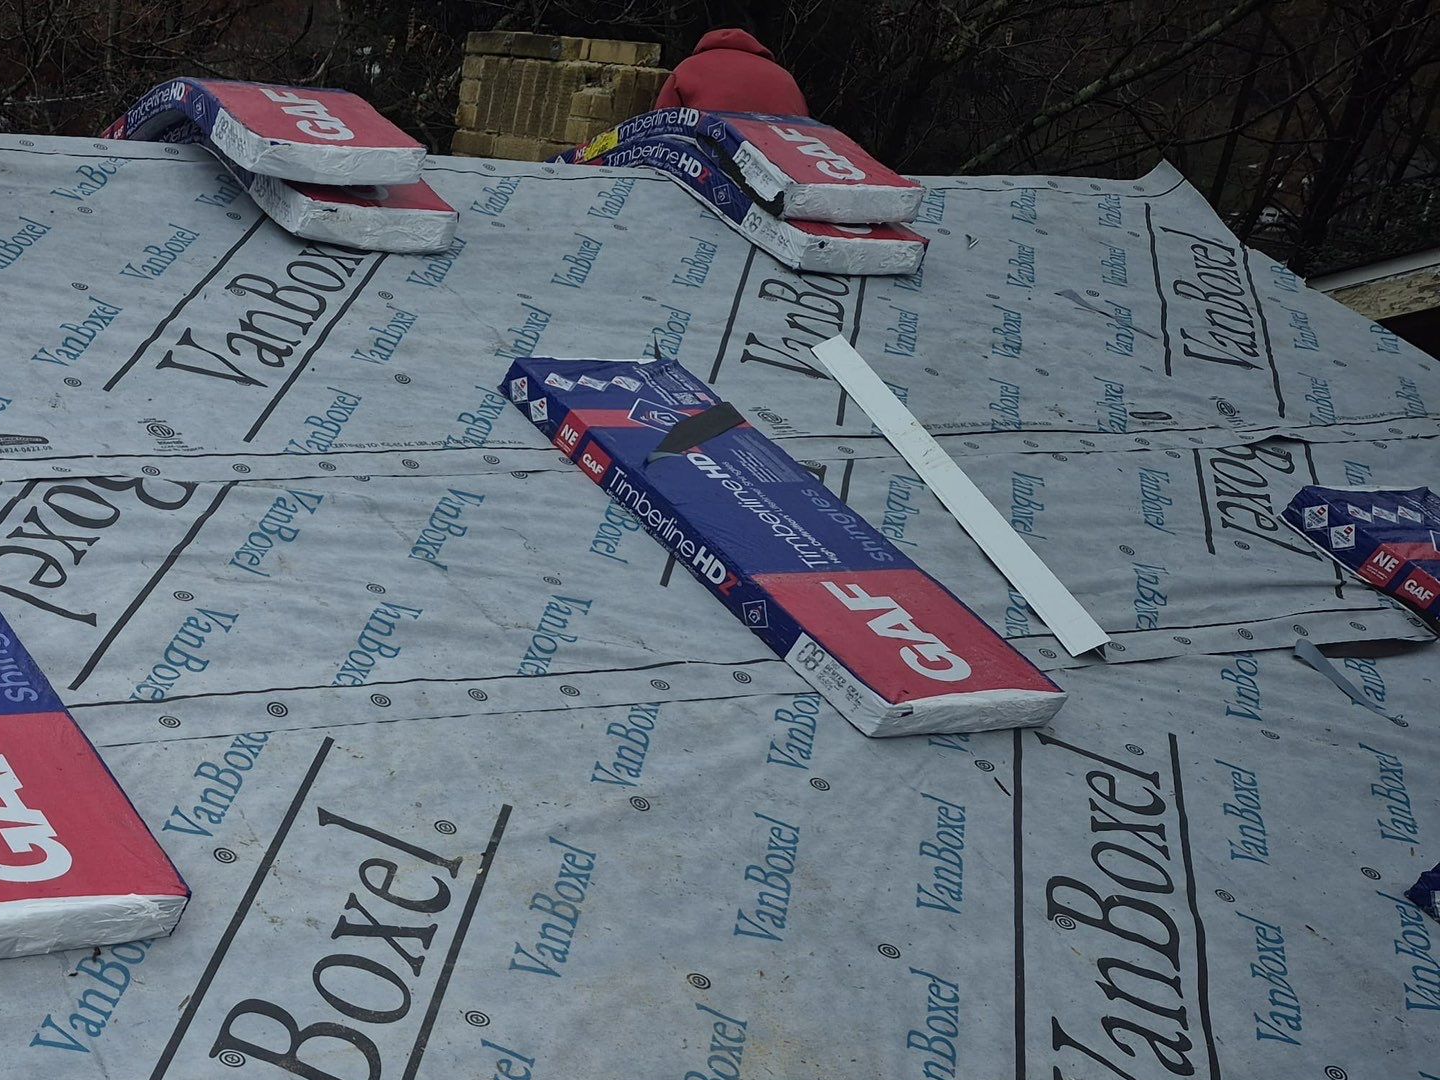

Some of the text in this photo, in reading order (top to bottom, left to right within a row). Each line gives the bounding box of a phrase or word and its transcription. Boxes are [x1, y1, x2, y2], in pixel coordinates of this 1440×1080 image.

[259, 88, 356, 141] GAF
[605, 143, 679, 167] Timberline
[767, 124, 867, 181] GAF
[120, 223, 200, 284] VanBoxel
[551, 232, 603, 289] VanBoxel
[31, 295, 123, 369] VanBoxel
[1160, 226, 1265, 370] VanBoxel
[560, 423, 578, 446] NE
[582, 452, 605, 476] GAF
[229, 489, 325, 577] VanBoxel
[408, 489, 486, 571] VanBoxel
[608, 465, 695, 560] Timberline
[721, 477, 824, 570] Timberline
[801, 487, 895, 564] Shingles
[1373, 551, 1399, 573] NE
[1404, 579, 1434, 602] GAF
[820, 580, 972, 683] GAF
[734, 812, 802, 945] VanBoxel
[916, 795, 967, 918] VanBoxel
[508, 836, 598, 980] VanBoxel
